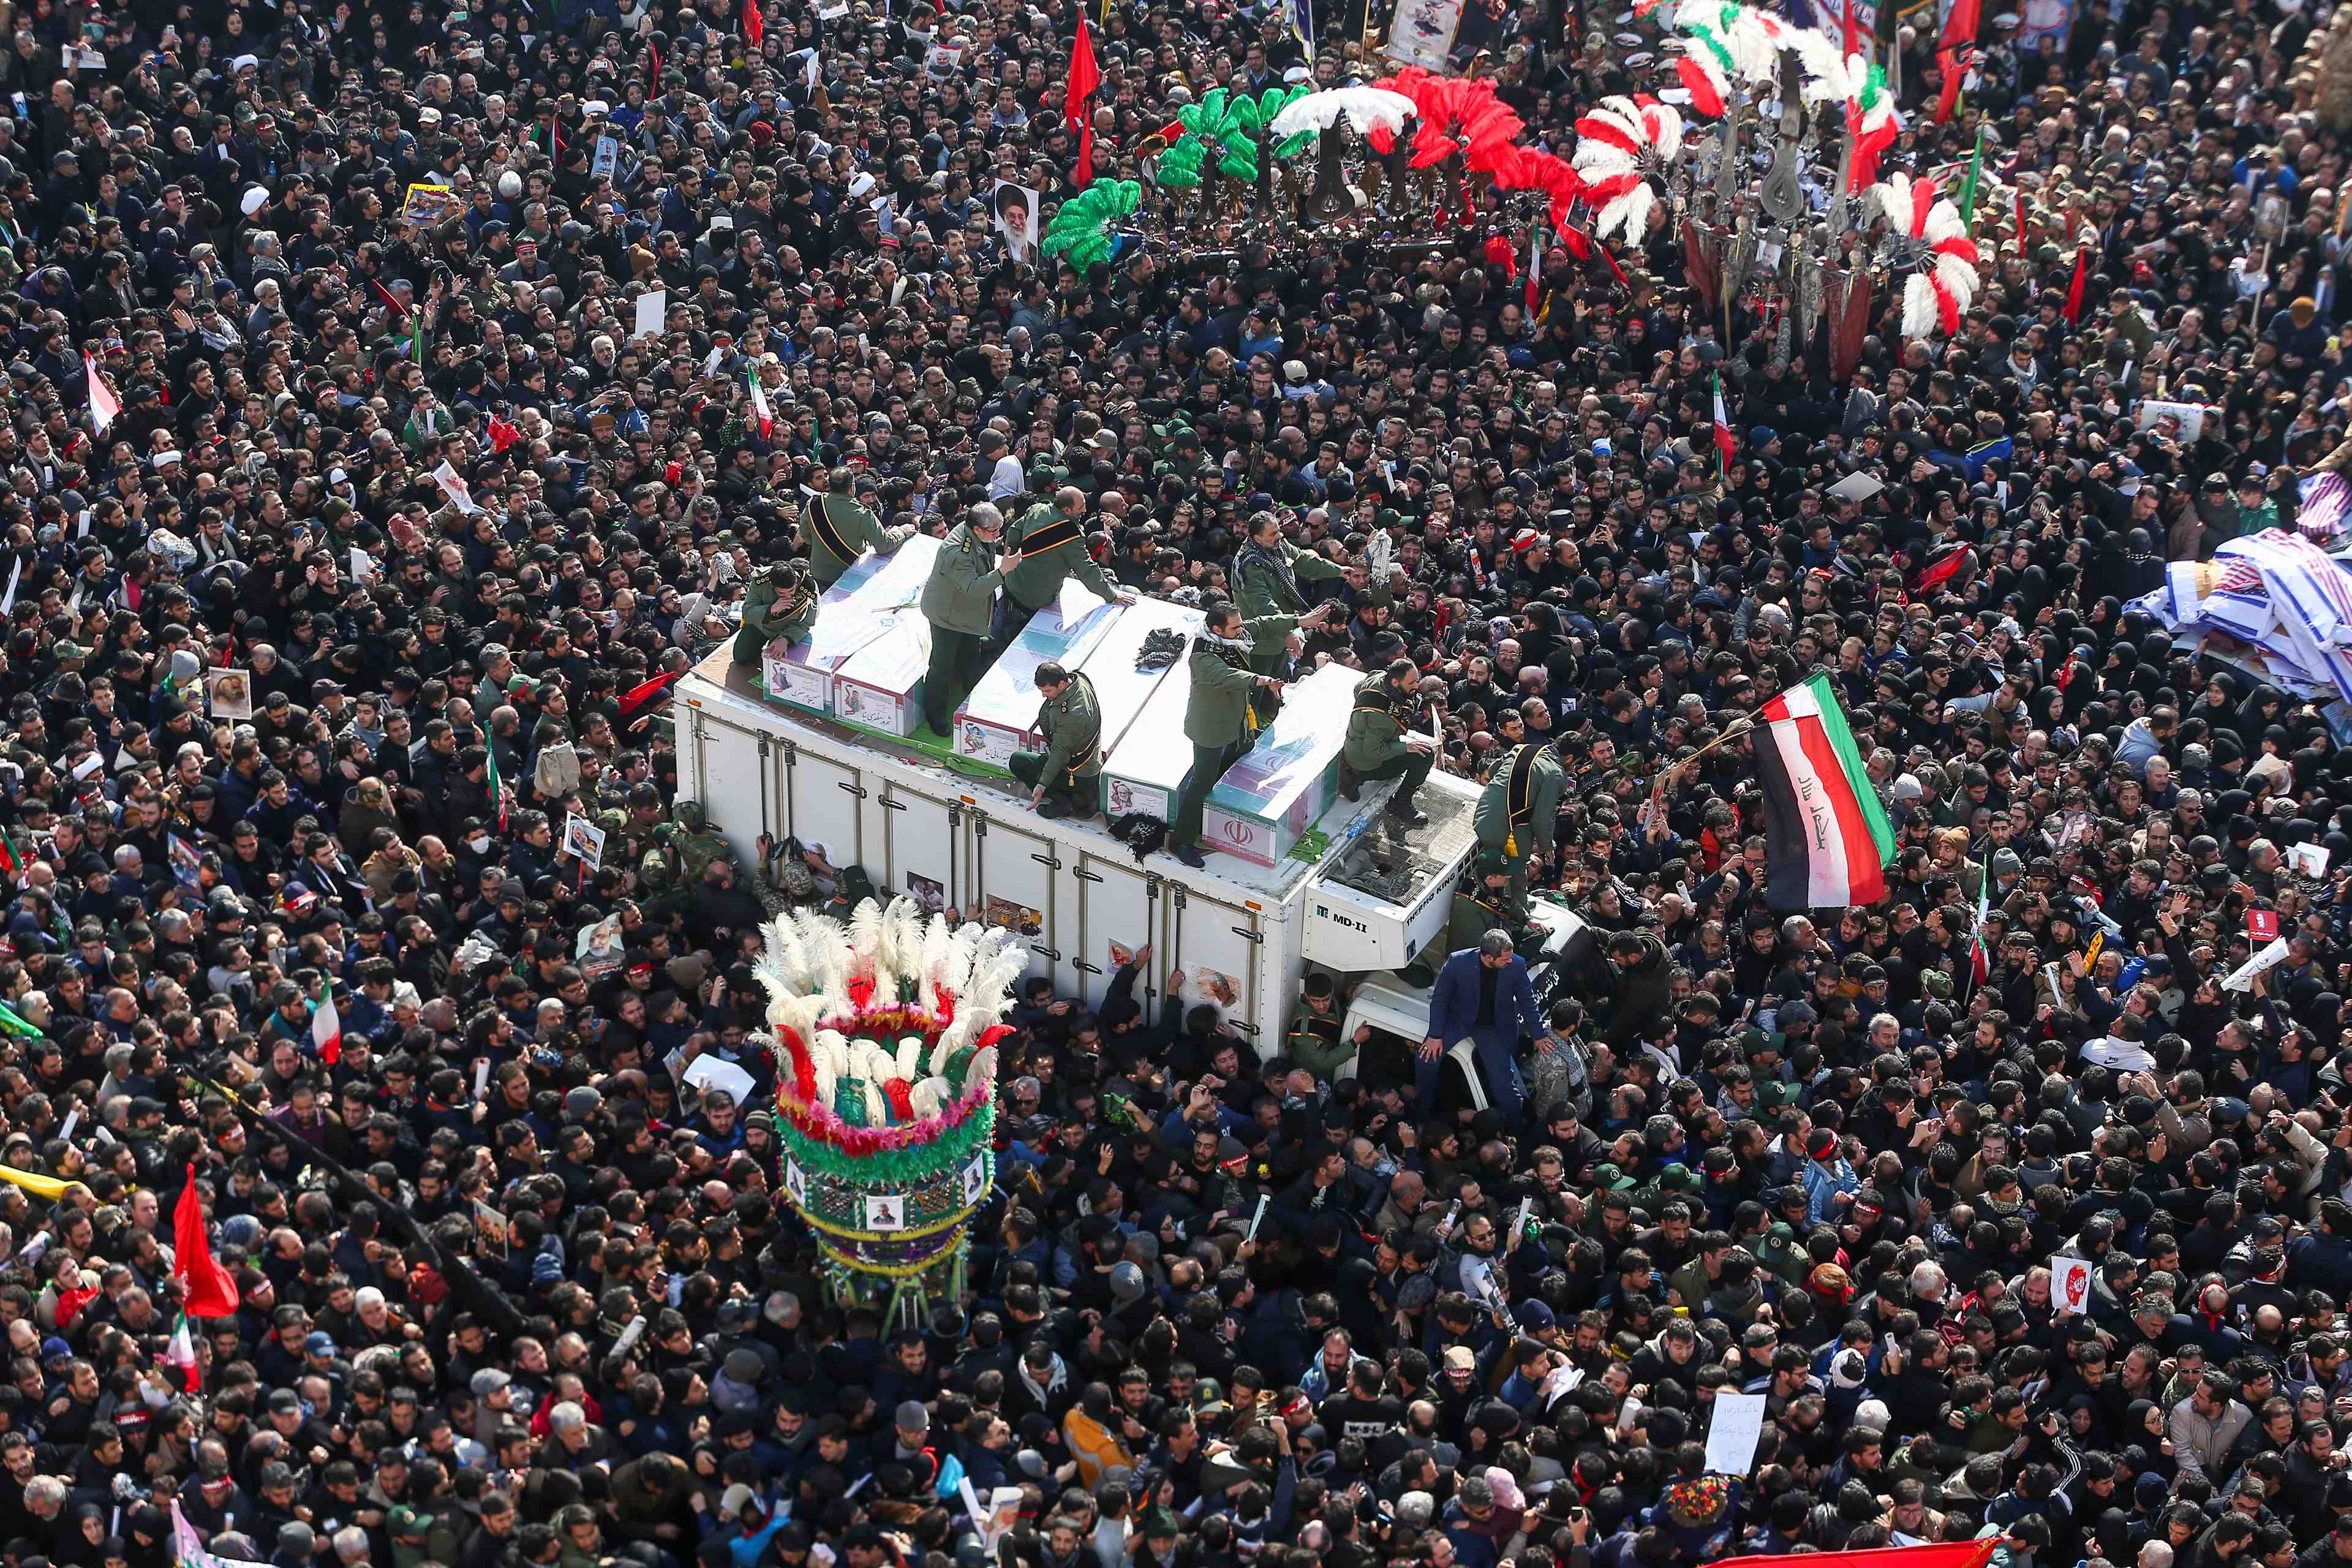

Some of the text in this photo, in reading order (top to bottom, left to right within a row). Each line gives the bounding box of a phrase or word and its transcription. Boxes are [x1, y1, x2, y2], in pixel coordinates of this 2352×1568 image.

[1406, 892, 1434, 926] THERMO
[1436, 872, 1455, 894] KING
[1333, 913, 1367, 933] MD-II
